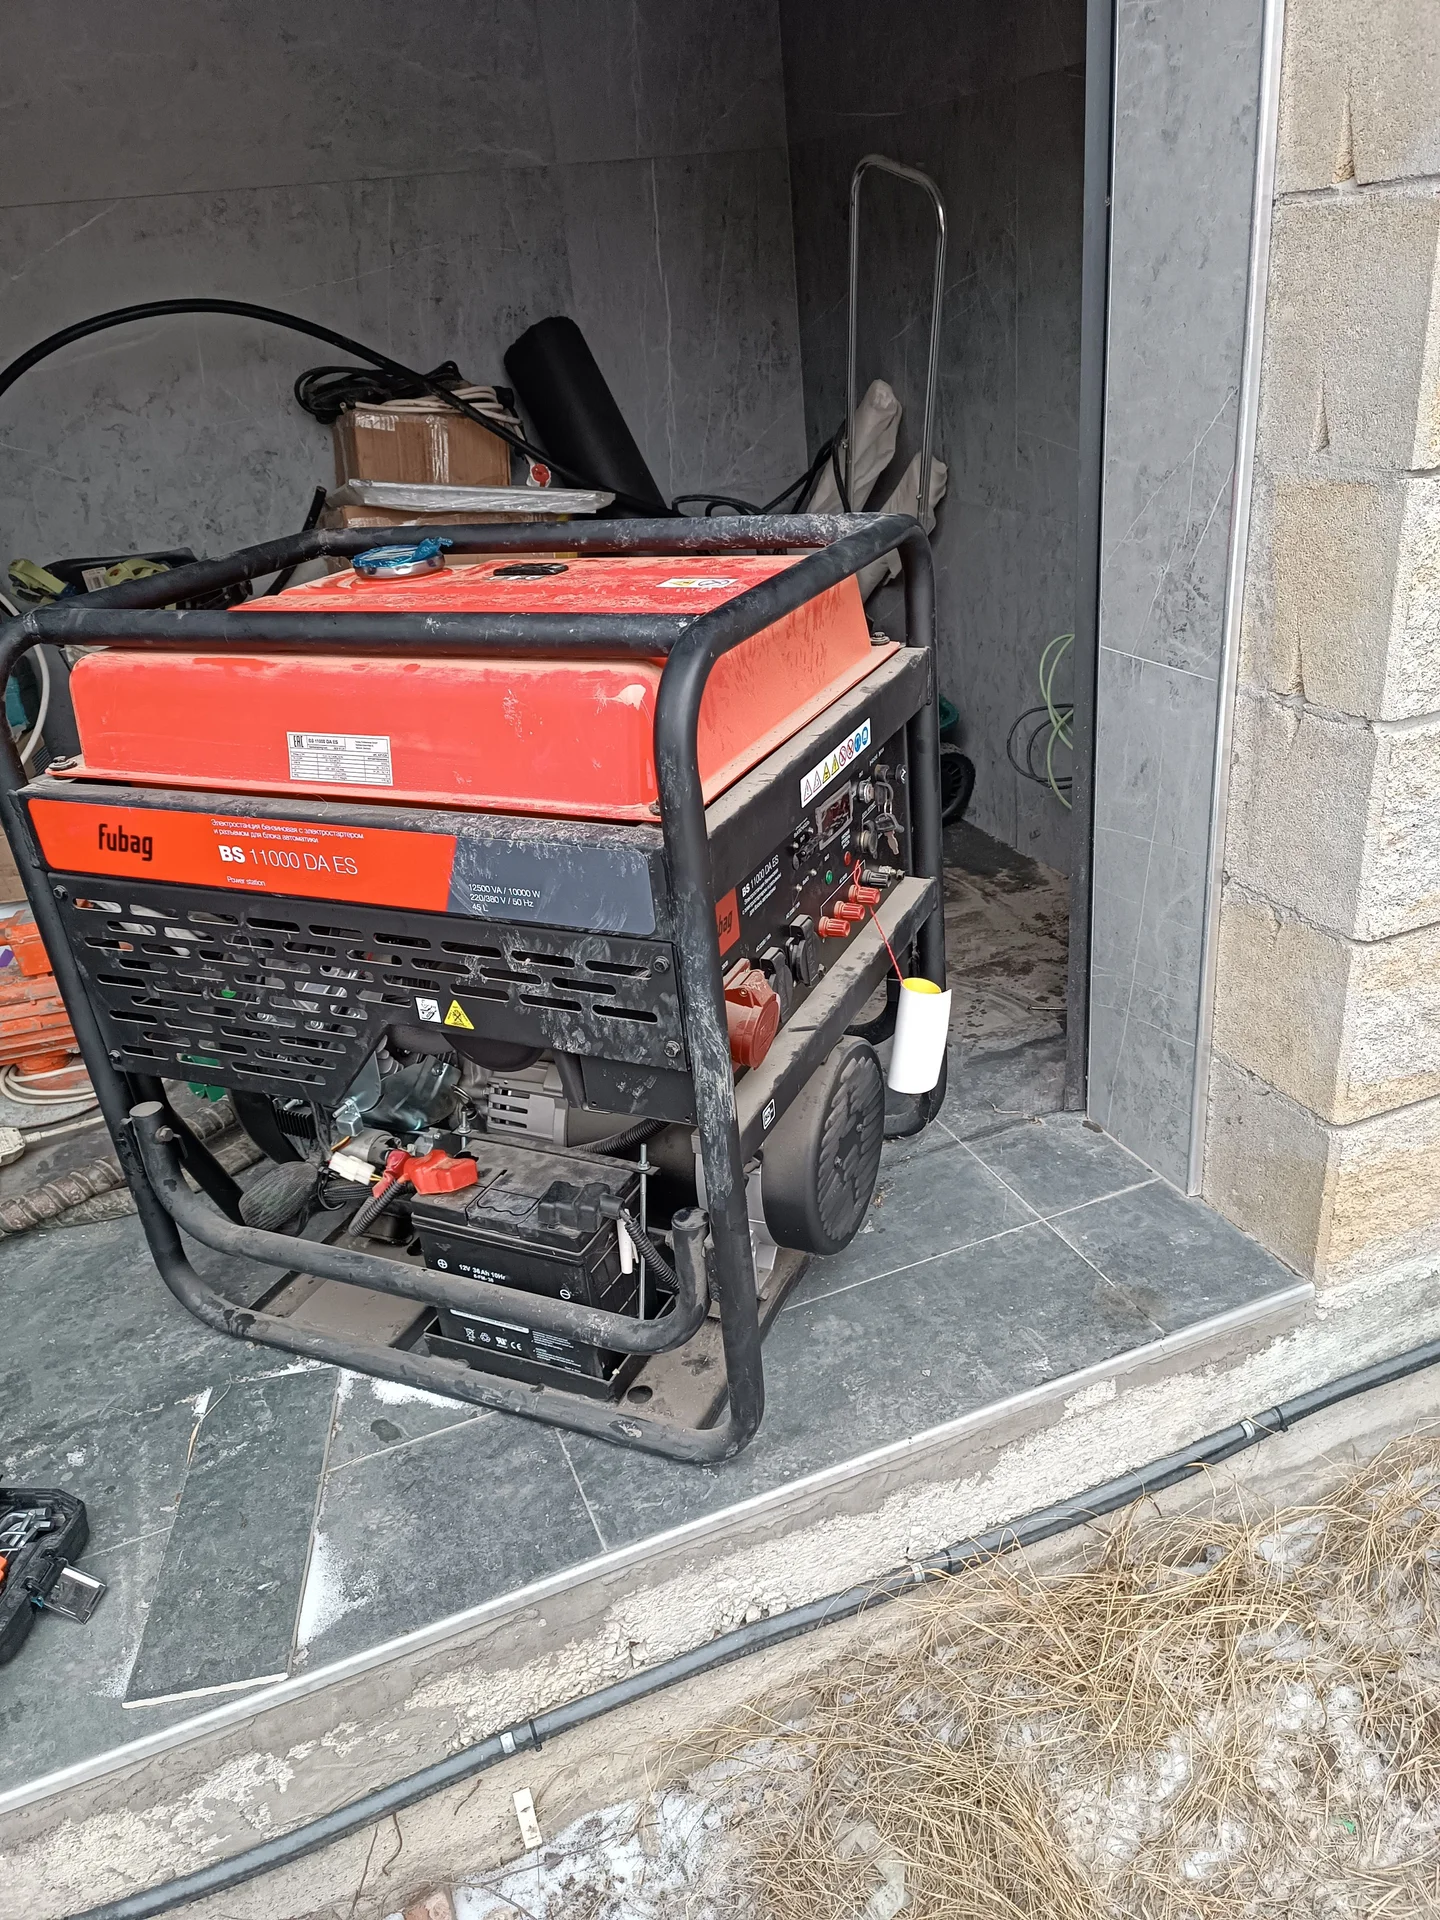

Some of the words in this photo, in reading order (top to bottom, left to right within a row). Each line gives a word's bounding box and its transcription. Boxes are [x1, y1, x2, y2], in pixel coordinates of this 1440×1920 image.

[210, 818, 260, 830] Электростанция
[98, 823, 153, 862] fubag
[218, 845, 246, 864] BS
[250, 849, 300, 870] 11000
[304, 854, 331, 872] DA
[332, 856, 358, 876] ES
[226, 876, 245, 884] Power
[246, 877, 266, 886] station
[742, 883, 750, 898] BS
[750, 868, 765, 888] 11000
[764, 862, 772, 876] DA
[772, 854, 779, 868] ES
[468, 884, 490, 893] 12500
[491, 886, 502, 894] VA
[508, 888, 531, 898] 10000
[532, 890, 540, 898] W
[470, 894, 500, 904] 220/380
[500, 896, 506, 904] V
[524, 900, 534, 908] Hz
[718, 910, 733, 937] bag
[458, 1264, 471, 1272] 12V
